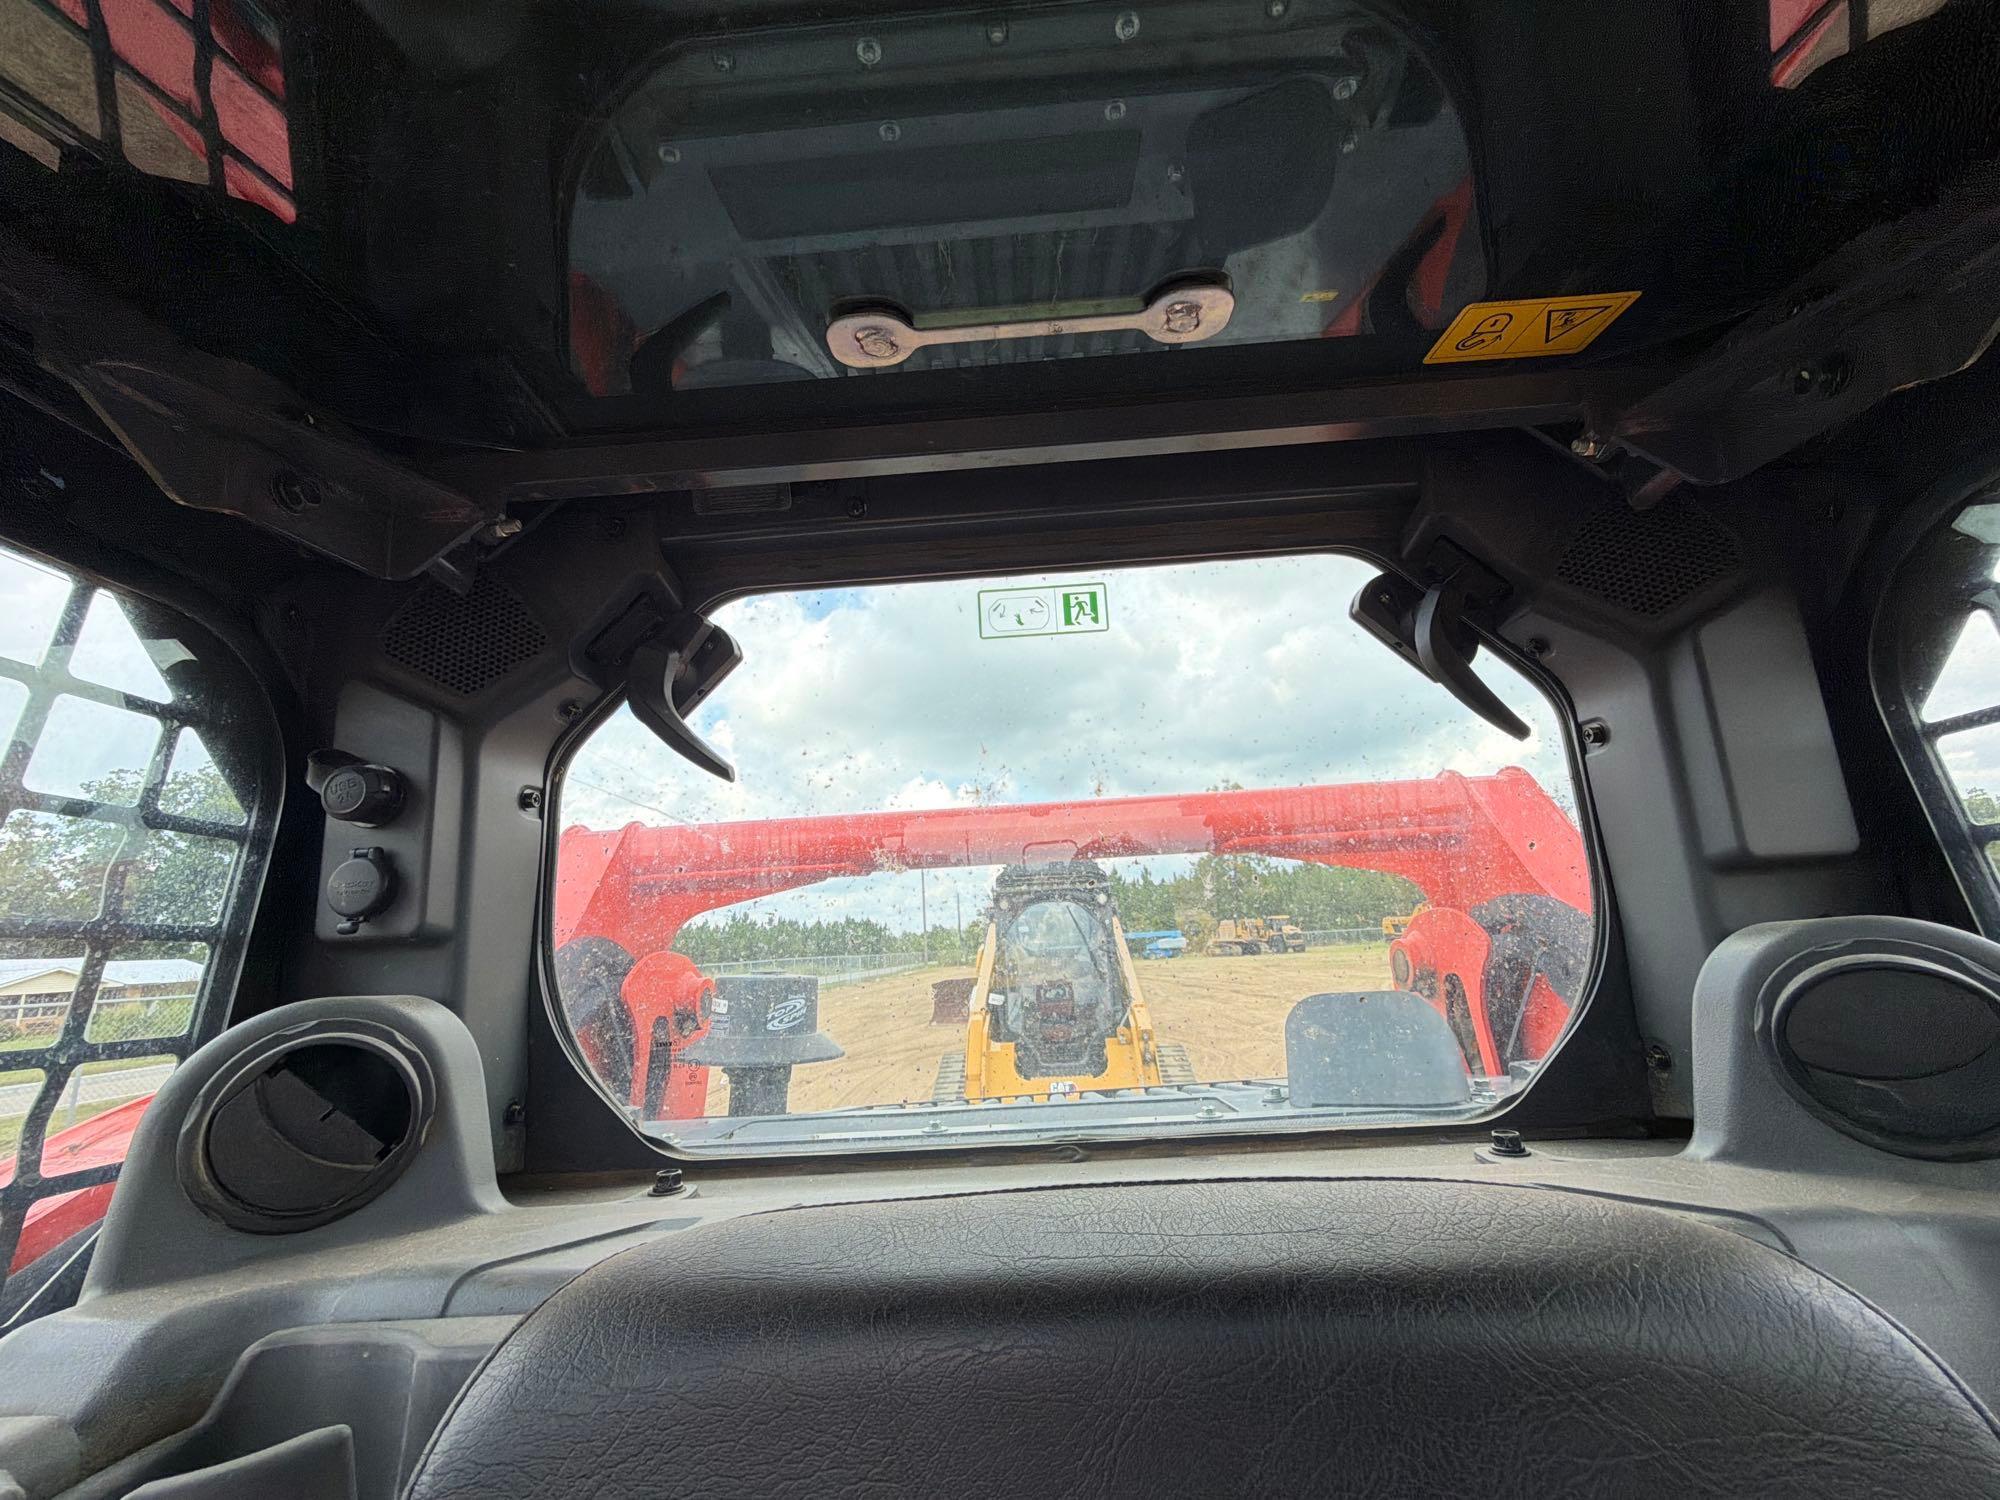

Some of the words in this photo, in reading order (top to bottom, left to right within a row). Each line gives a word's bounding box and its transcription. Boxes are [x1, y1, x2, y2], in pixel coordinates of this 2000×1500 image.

[766, 1005, 794, 1020] TOP
[782, 1006, 807, 1023] SPIN
[1050, 1082, 1070, 1093] CAT
